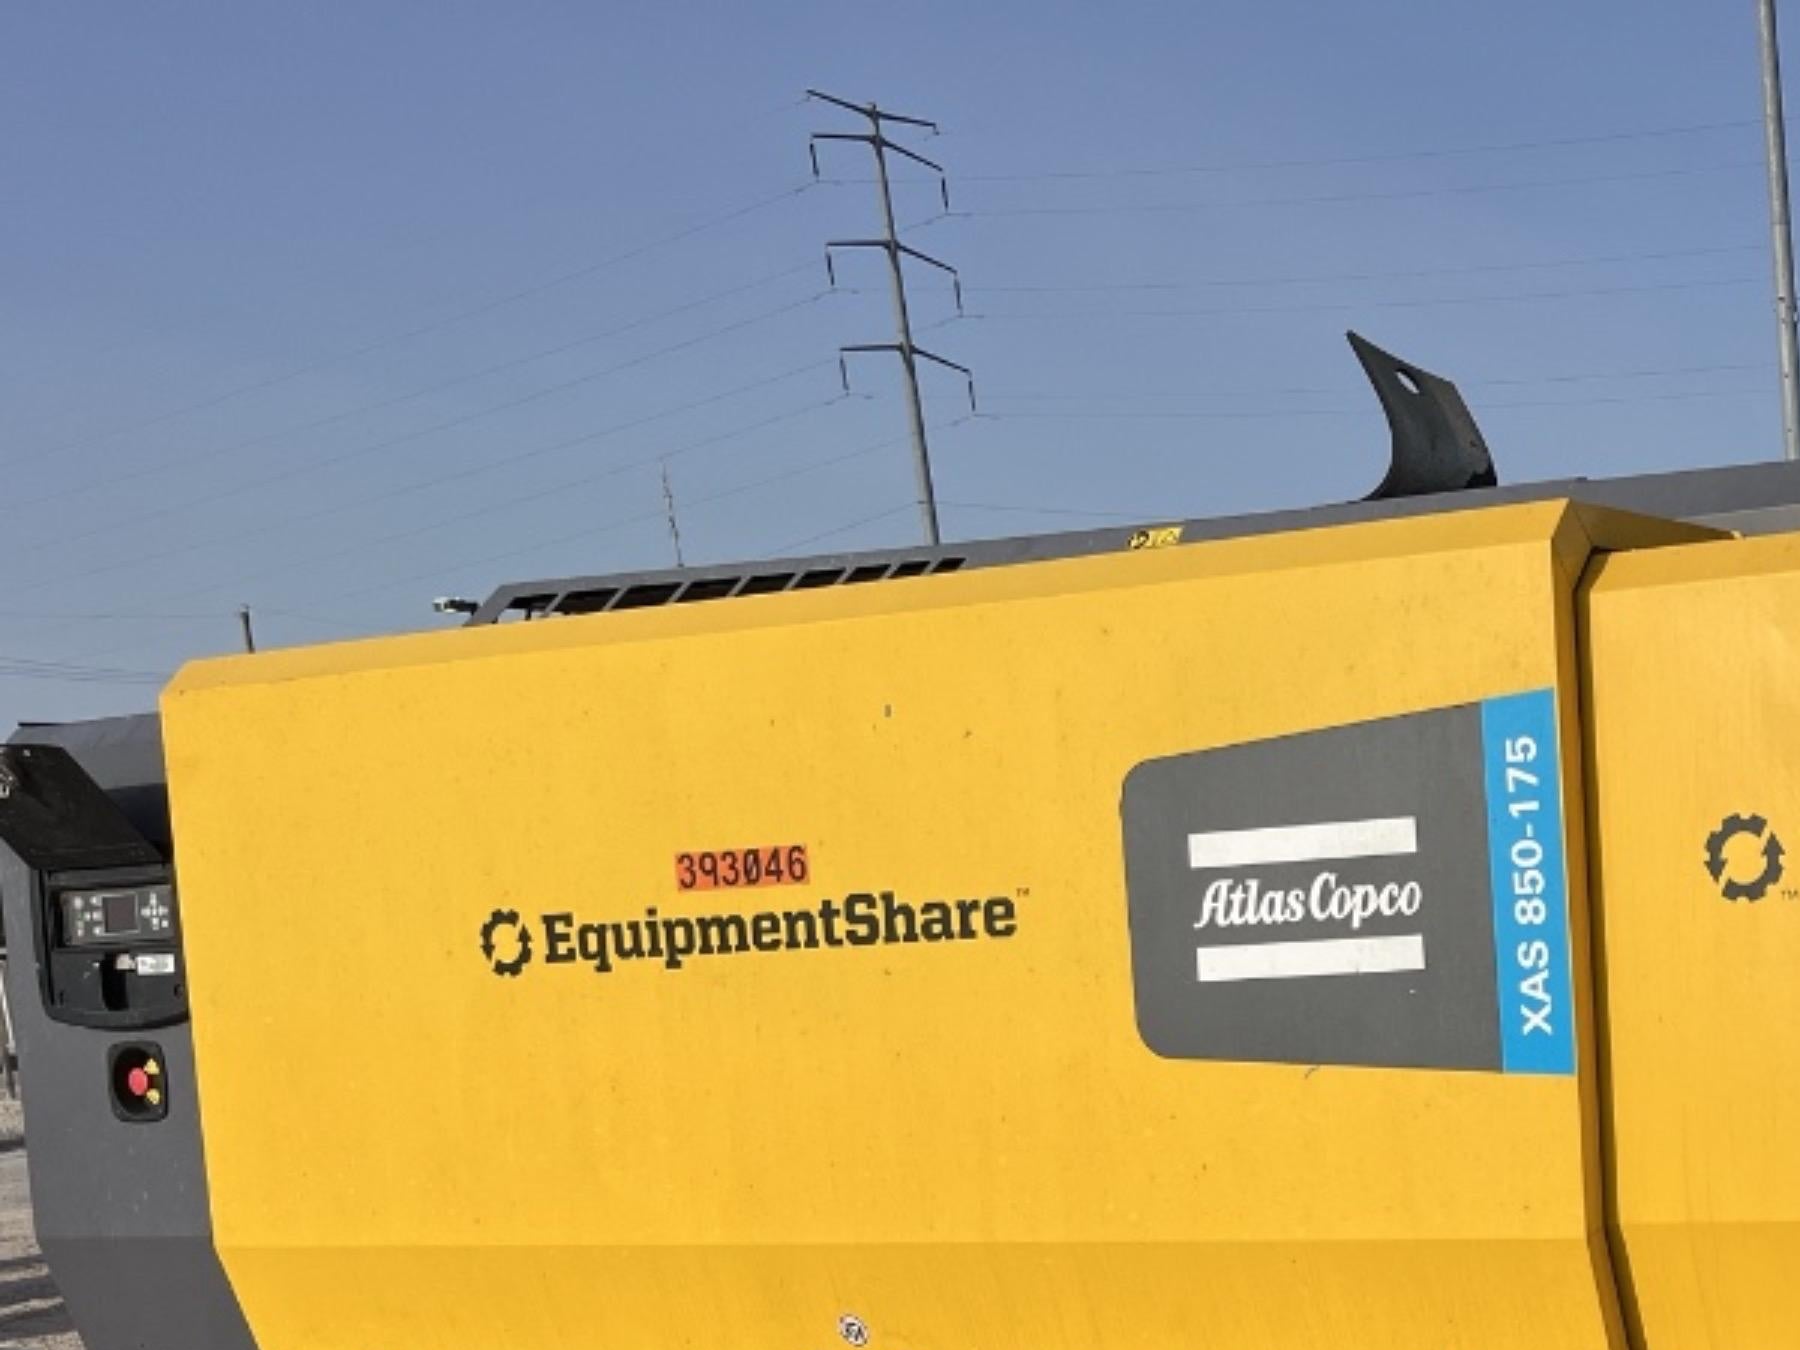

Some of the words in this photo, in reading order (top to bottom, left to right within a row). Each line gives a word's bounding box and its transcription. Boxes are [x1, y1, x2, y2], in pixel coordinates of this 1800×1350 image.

[677, 845, 807, 889] 393046
[1506, 736, 1547, 926] 850-175
[541, 893, 1016, 970] EquipmentShare
[1193, 878, 1306, 929] Atlas
[1309, 871, 1423, 930] Copco
[1515, 940, 1553, 1035] XAS
